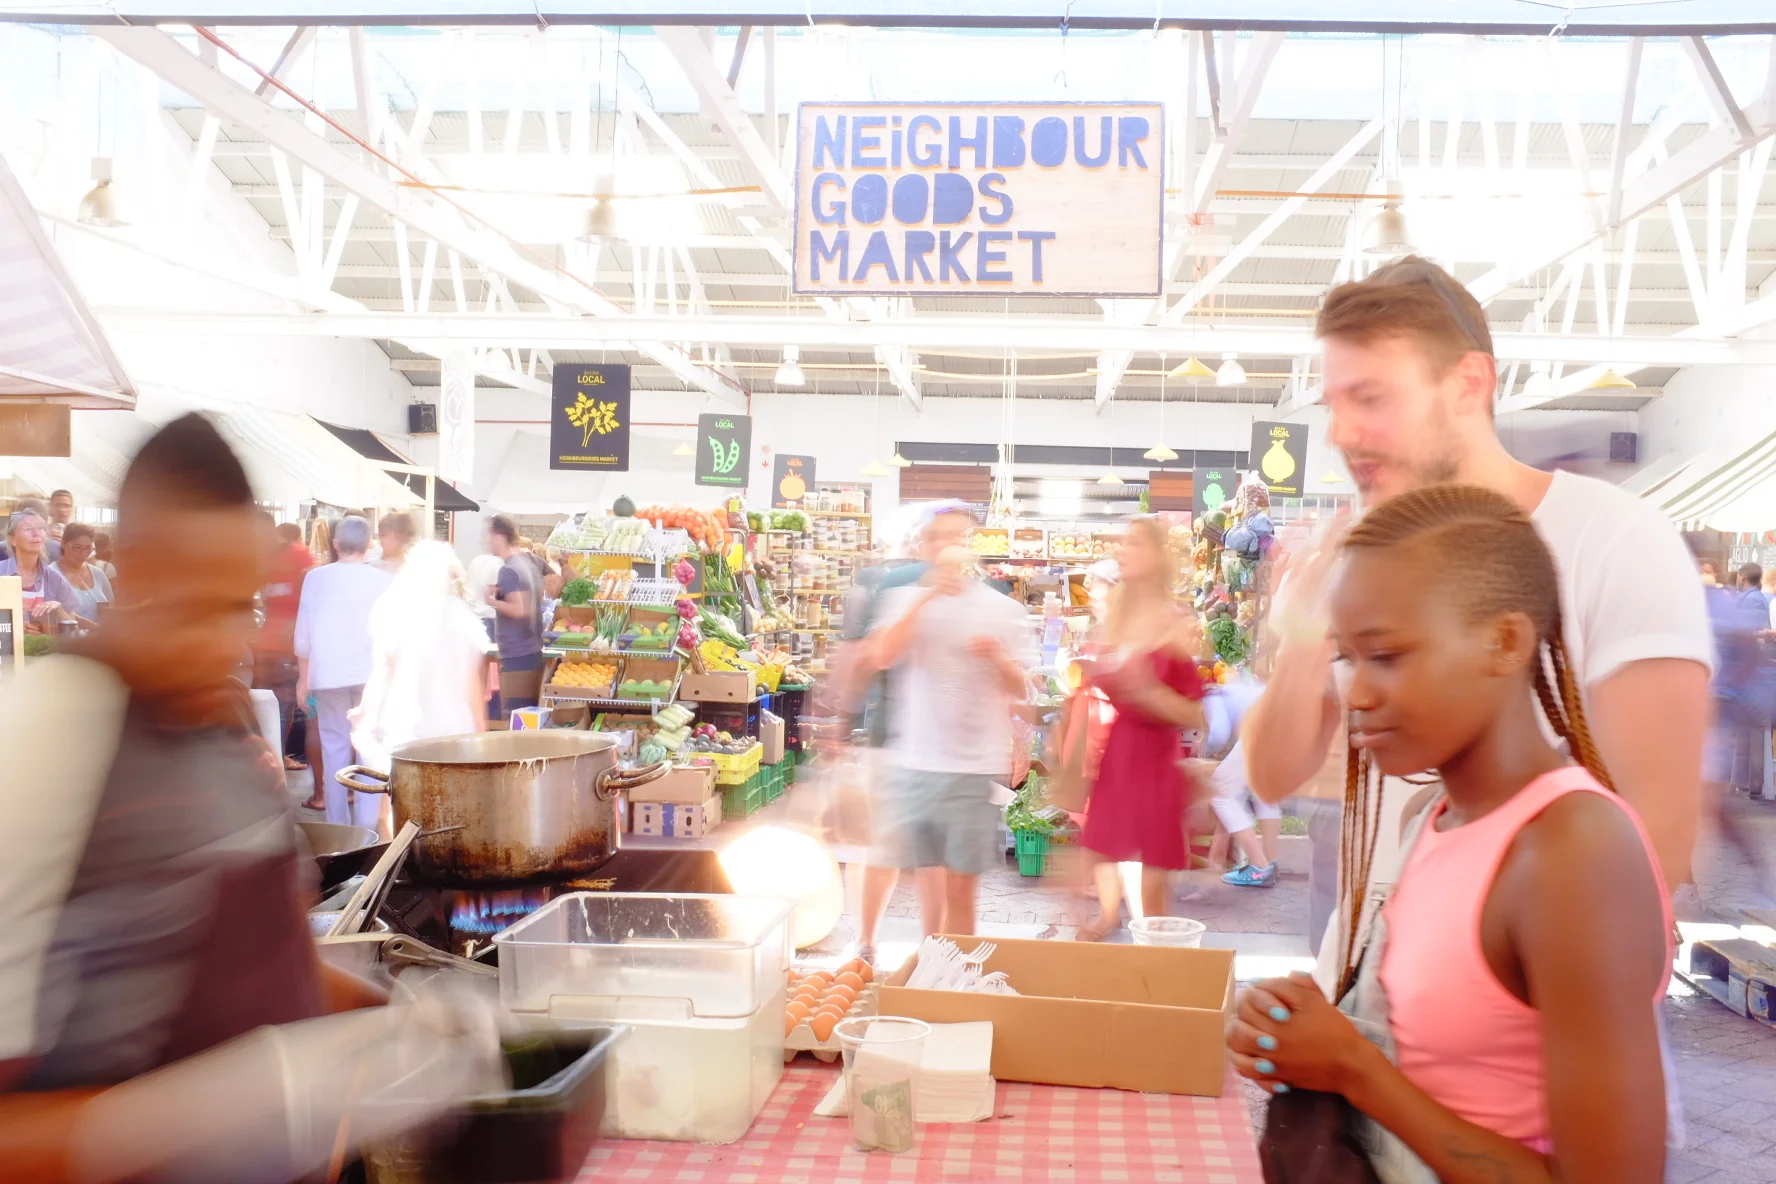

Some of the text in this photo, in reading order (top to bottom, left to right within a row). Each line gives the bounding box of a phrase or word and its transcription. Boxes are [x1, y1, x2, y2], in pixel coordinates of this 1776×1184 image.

[811, 172, 1014, 227] GOODS
[809, 230, 1056, 283] MARKET
[577, 375, 605, 384] LOCAL
[715, 420, 735, 429] LOCAL
[1269, 429, 1290, 438] LOCAL
